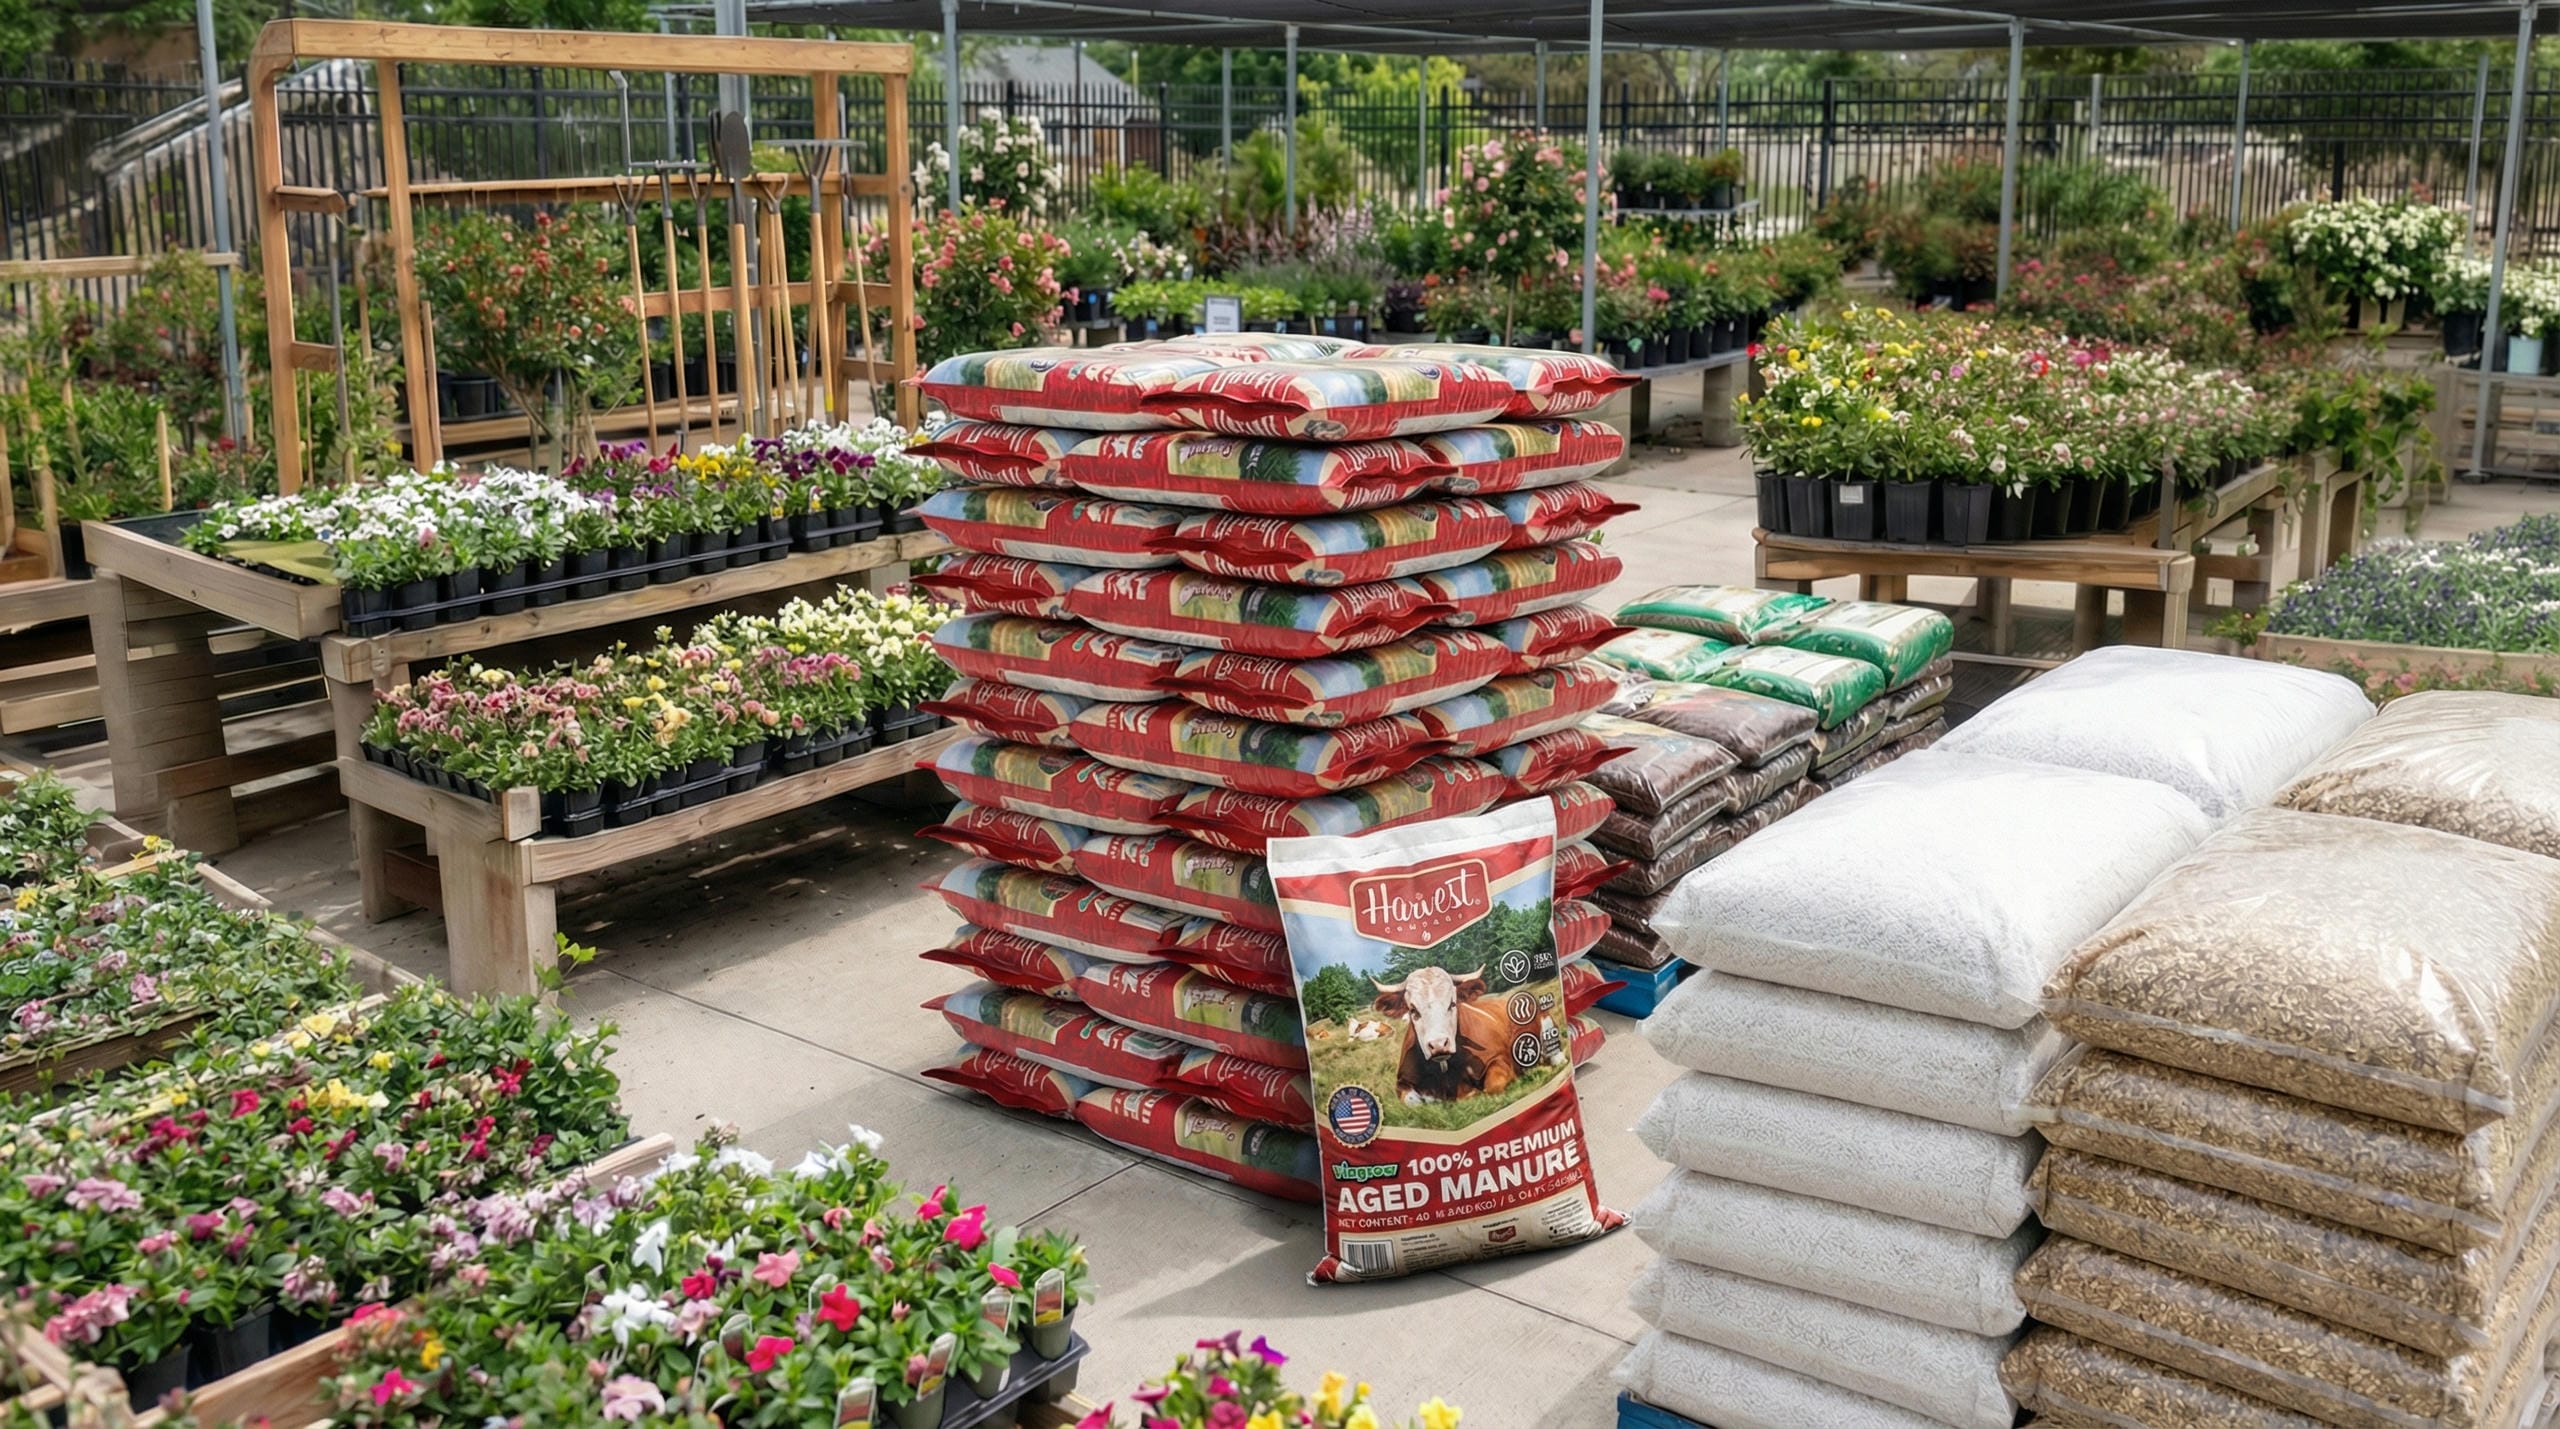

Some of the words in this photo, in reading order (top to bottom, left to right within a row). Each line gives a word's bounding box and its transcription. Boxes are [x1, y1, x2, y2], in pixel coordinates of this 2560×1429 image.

[1361, 868, 1478, 924] Harvest
[1338, 1182, 1430, 1213] AGED
[1441, 1138, 1580, 1204] MANURE
[1407, 1150, 1473, 1176] 100%
[1478, 1118, 1576, 1164] PREMIUM
[1338, 1218, 1355, 1228] NET
